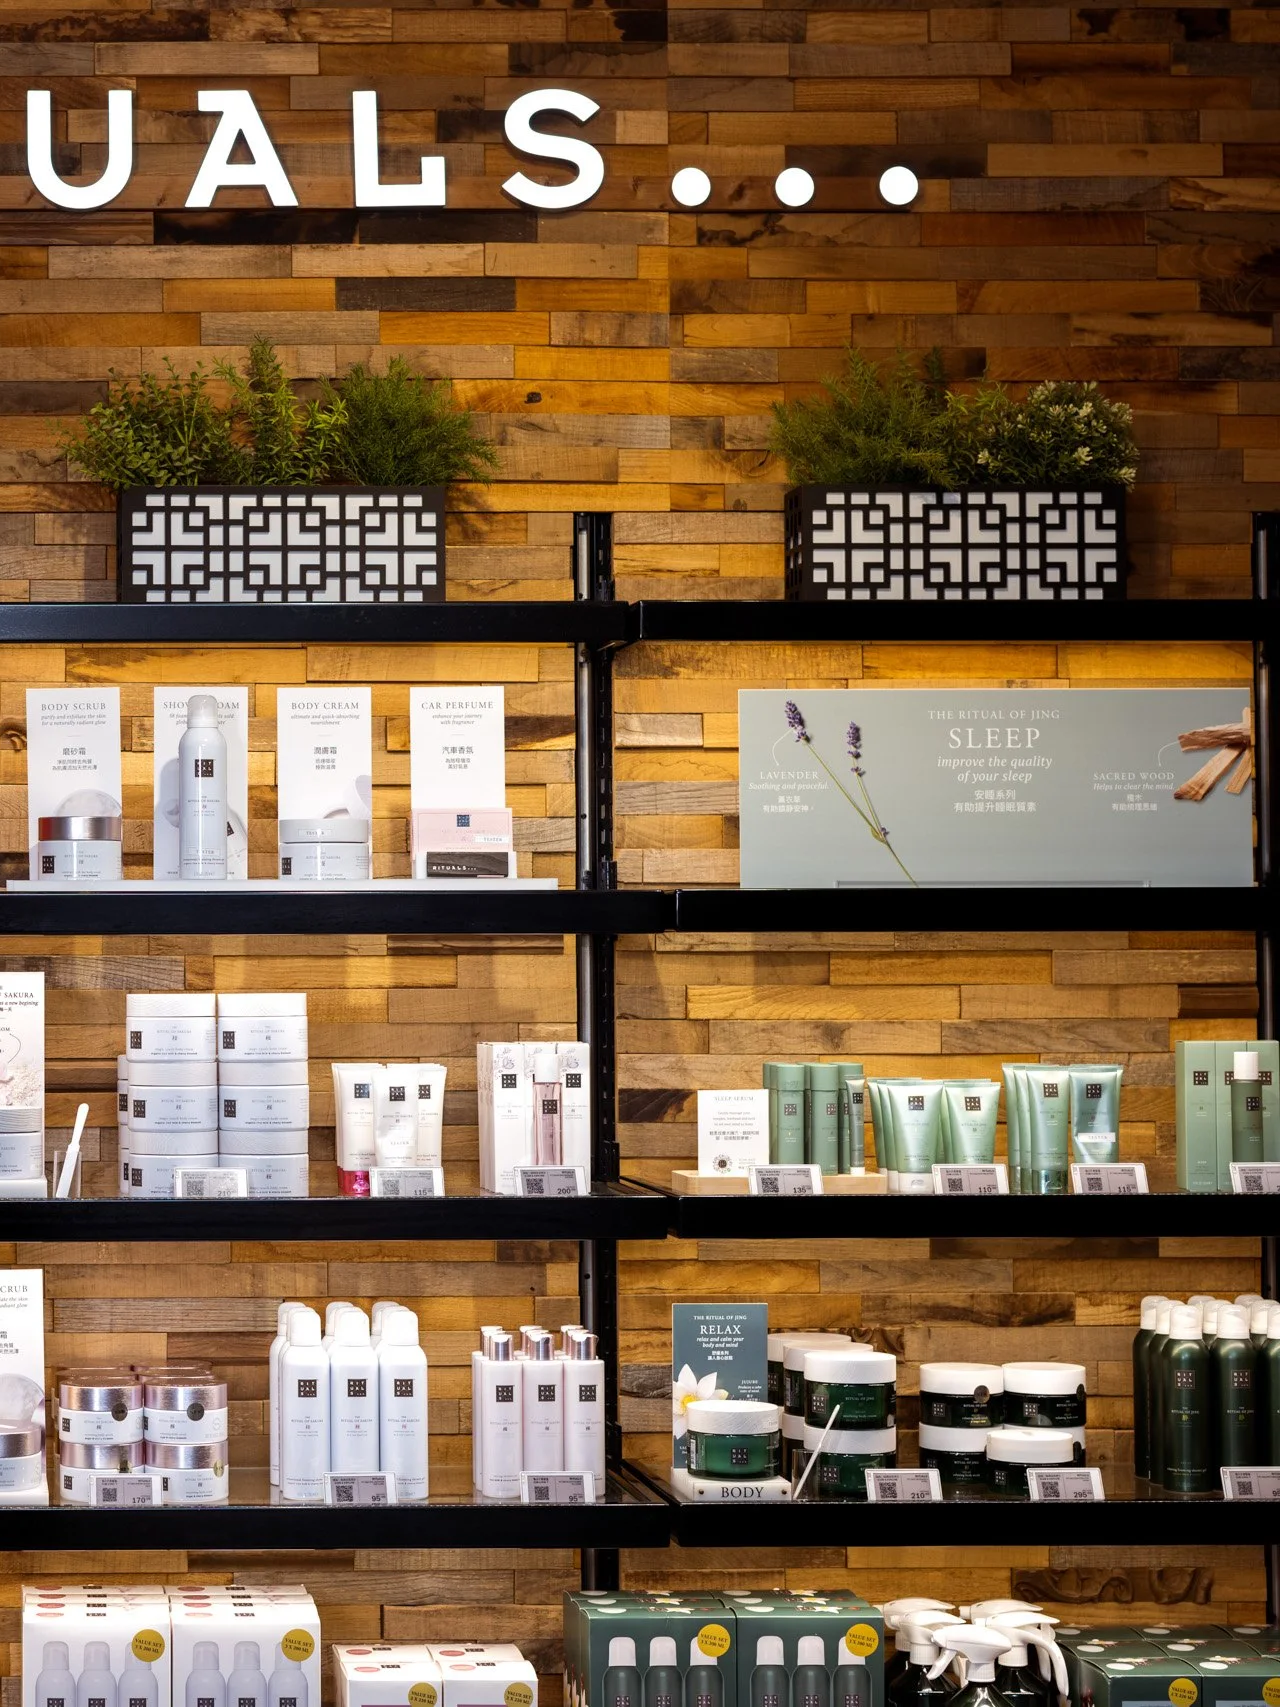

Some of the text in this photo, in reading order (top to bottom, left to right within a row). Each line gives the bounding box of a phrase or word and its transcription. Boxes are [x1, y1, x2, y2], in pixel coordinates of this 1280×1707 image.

[41, 702, 106, 711] BODY SCRUB
[217, 701, 239, 709] OAM
[291, 702, 359, 710] BODY CREAM
[421, 701, 494, 710] CAR PERFUME
[927, 709, 1060, 721] THE RITUAL OF JING
[948, 727, 1040, 749] SLEEP
[937, 756, 1053, 771] improve the quality
[760, 771, 819, 780] LAVENDER
[957, 770, 1033, 784] of your sleep
[1093, 771, 1175, 780] SACRED WOOD
[748, 782, 781, 791] Soothing
[781, 782, 796, 790] and
[1093, 783, 1113, 792] Helps
[1123, 782, 1140, 790] clear
[1142, 782, 1154, 790] the
[1156, 782, 1175, 791] mind.
[974, 789, 1016, 800] 安睡系列
[700, 1325, 741, 1335] RELAX
[720, 1486, 765, 1498] BODY
[135, 1637, 151, 1646] VALUE
[700, 1633, 717, 1641] VALUE
